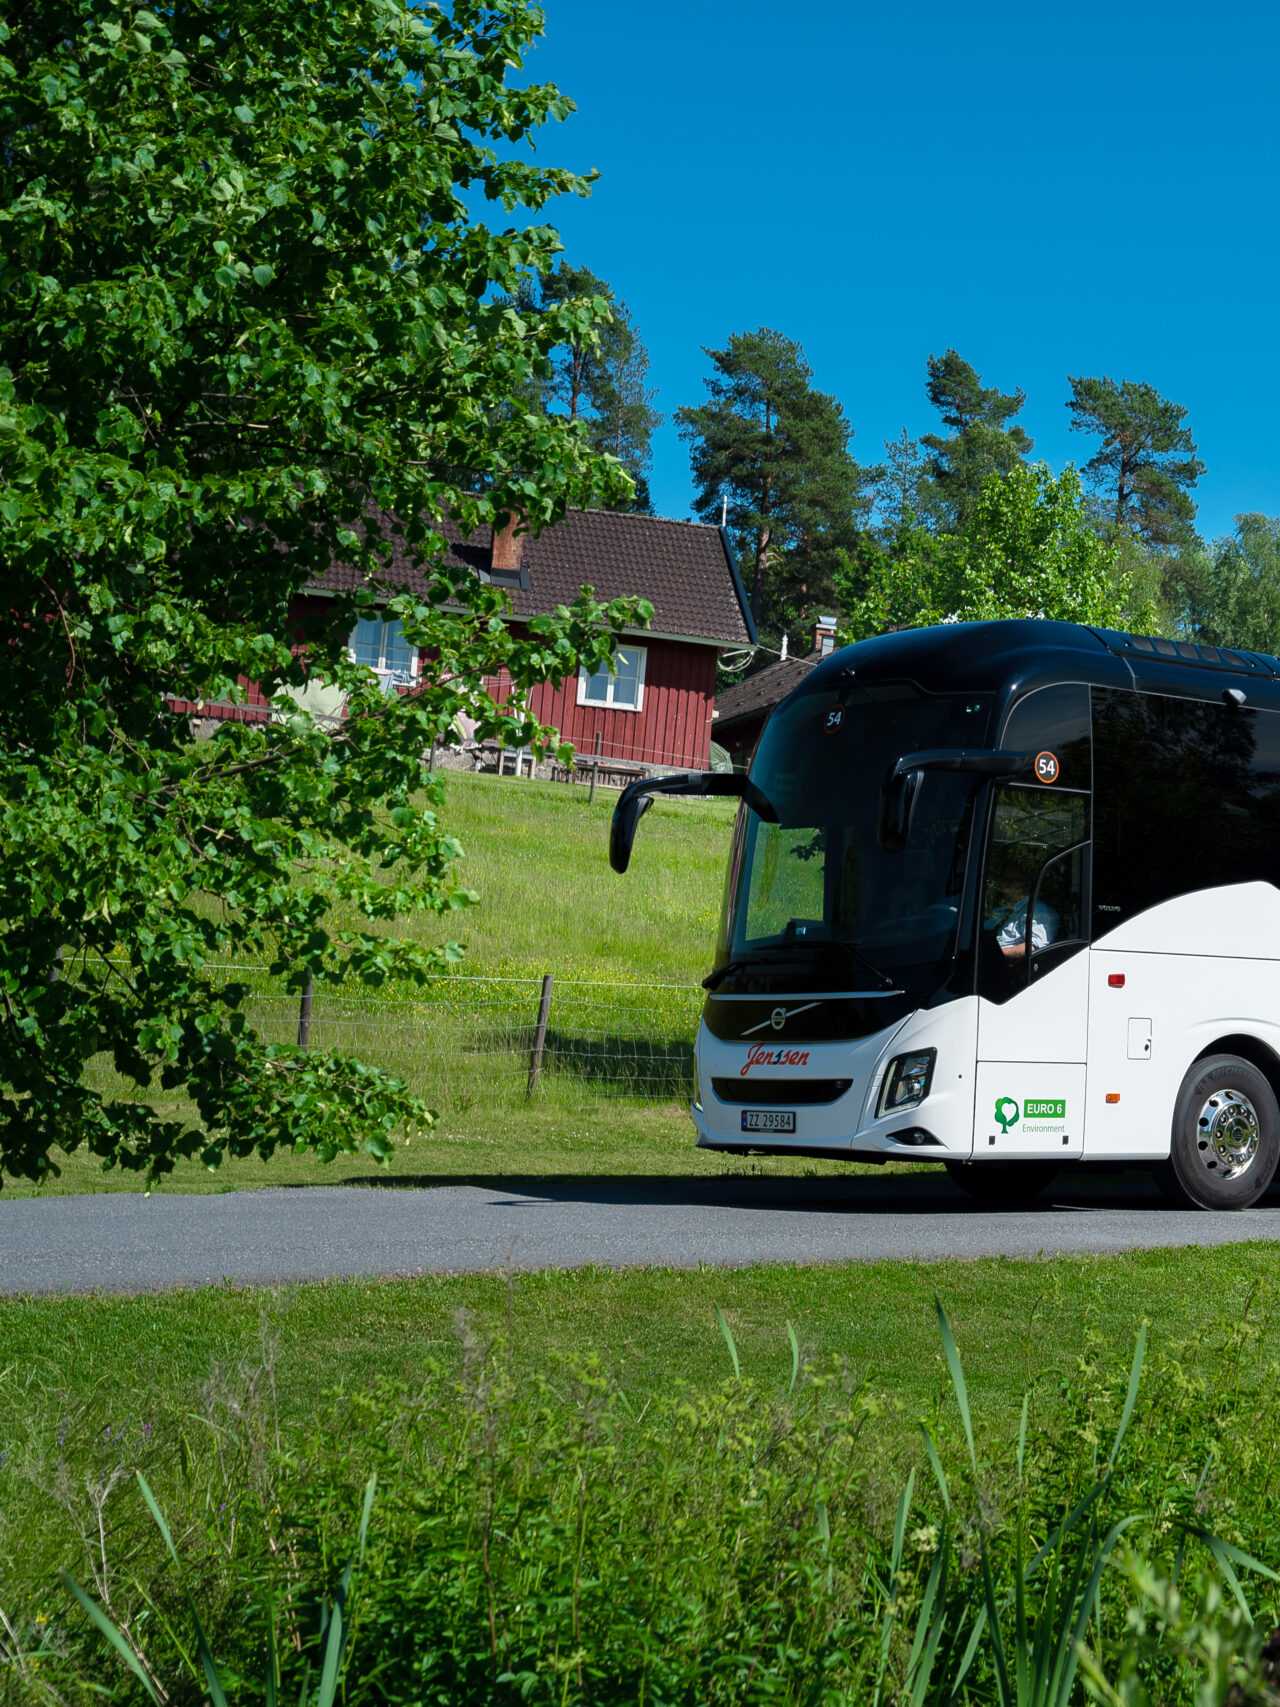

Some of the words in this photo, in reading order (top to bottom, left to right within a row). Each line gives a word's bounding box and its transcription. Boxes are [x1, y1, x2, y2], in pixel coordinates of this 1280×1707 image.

[827, 711, 842, 726] 54
[1039, 758, 1055, 775] 54
[740, 1041, 810, 1076] Jenssen
[1027, 1103, 1054, 1114] EURO
[1056, 1103, 1063, 1114] 6
[748, 1113, 760, 1127] ZZ
[1022, 1123, 1065, 1133] Environment
